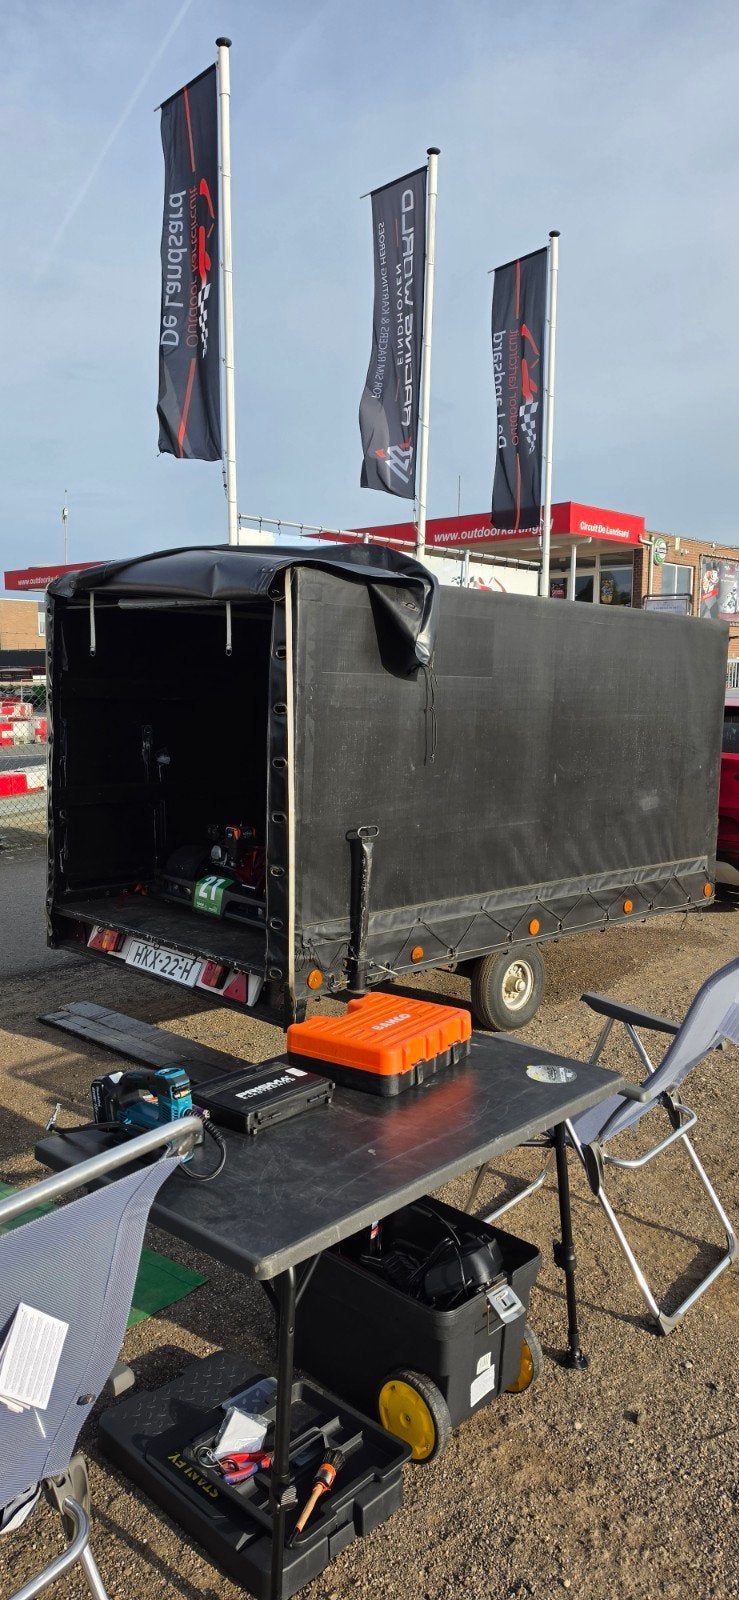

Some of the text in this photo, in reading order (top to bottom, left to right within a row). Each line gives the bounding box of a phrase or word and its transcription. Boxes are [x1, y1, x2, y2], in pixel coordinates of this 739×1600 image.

[580, 521, 630, 538] Circuit De Landsard
[199, 876, 226, 900] 21
[132, 945, 194, 981] HKX-22-H
[371, 1013, 411, 1031] BAHCO
[167, 1453, 219, 1498] STANLEY
